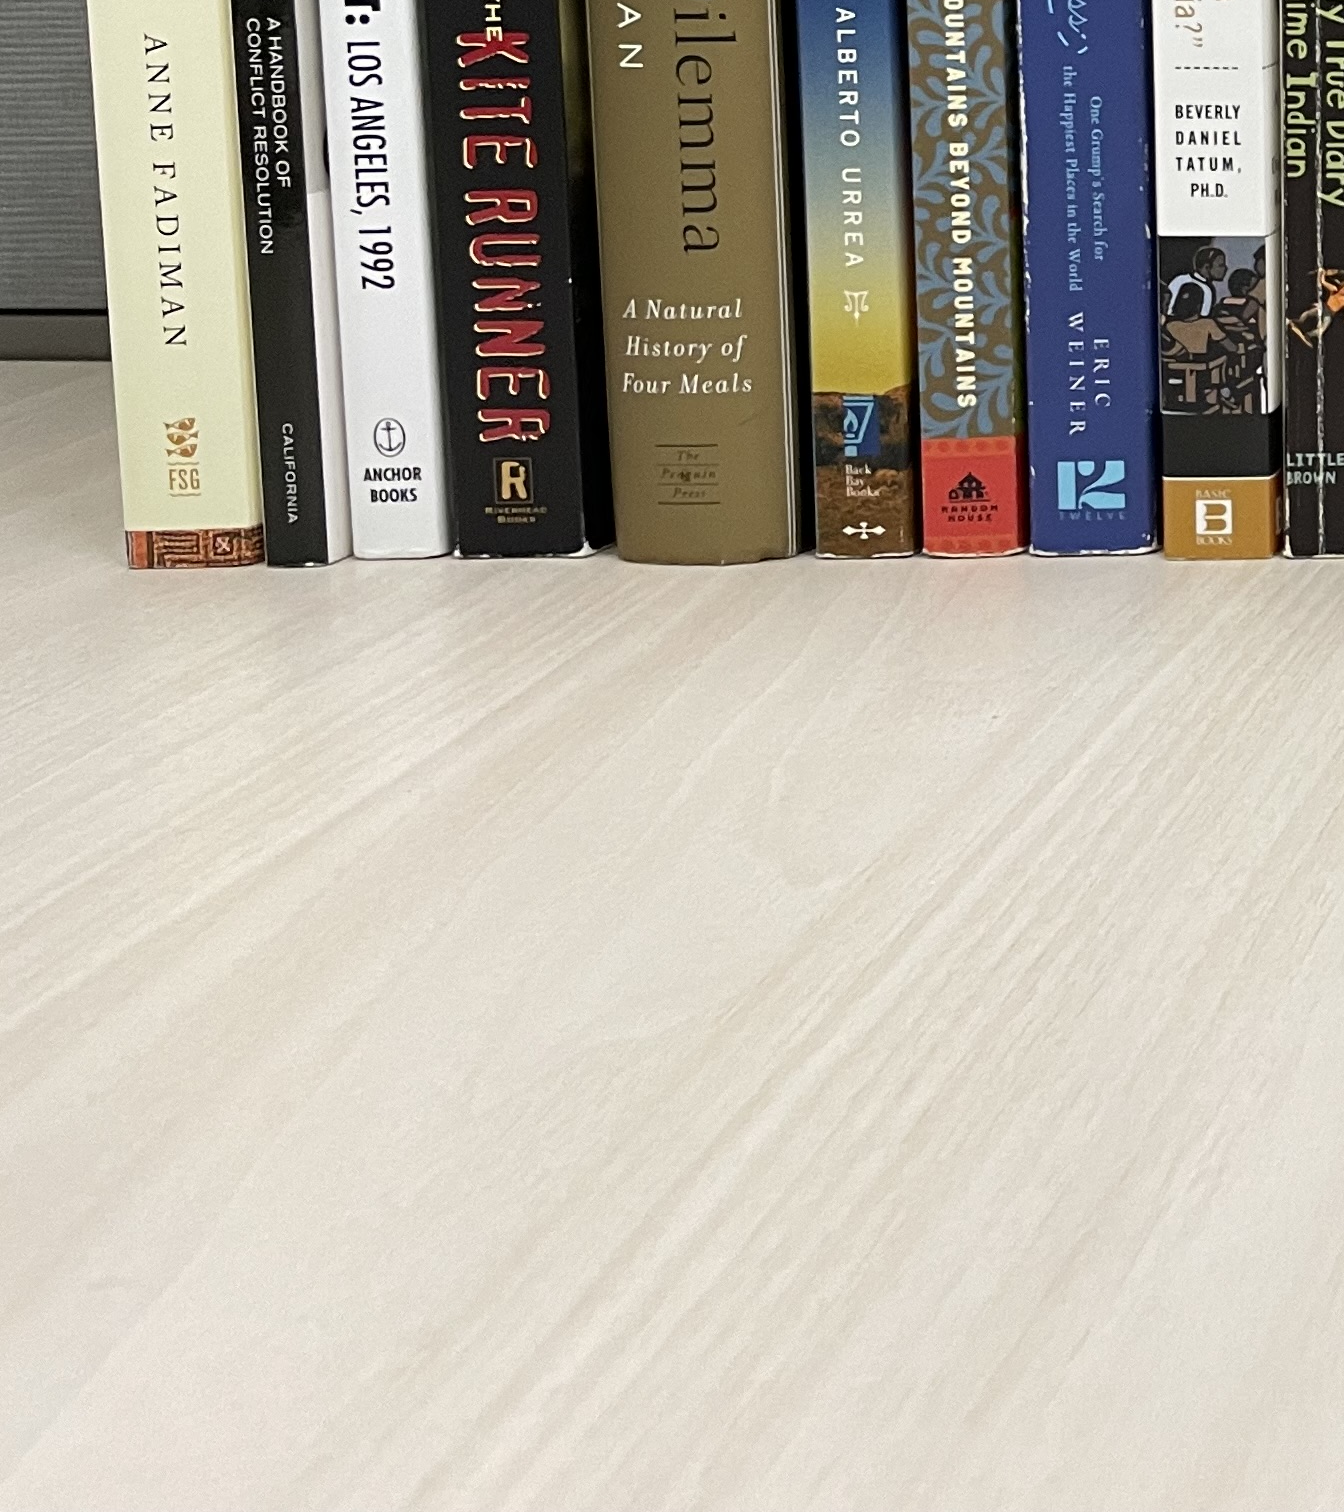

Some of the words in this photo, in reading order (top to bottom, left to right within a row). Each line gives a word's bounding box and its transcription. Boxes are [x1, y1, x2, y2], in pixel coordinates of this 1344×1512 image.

[347, 41, 382, 87] LOS
[144, 34, 174, 142] ANNE
[456, 31, 541, 169] KITE
[1175, 104, 1241, 119] BEVERLY
[350, 96, 390, 214] ANGELES,
[1175, 131, 1241, 146] DANIEL
[1175, 157, 1242, 174] TATUM,
[1190, 183, 1229, 198] PH.D.
[152, 162, 187, 347] FADIMAN
[357, 226, 395, 290] 1992
[464, 189, 551, 444] RUNNER
[623, 299, 637, 319] A
[646, 299, 743, 320] Natural
[625, 336, 712, 364] History
[721, 335, 748, 363] of
[623, 373, 671, 394] Four
[679, 374, 753, 395] Meals
[1068, 312, 1086, 435] WEINER
[1093, 339, 1111, 408] ERIC
[168, 468, 200, 491] FSG
[282, 423, 298, 524] CALIFORNIA
[363, 467, 422, 482] ANCHOR
[370, 488, 418, 503] BOOKS
